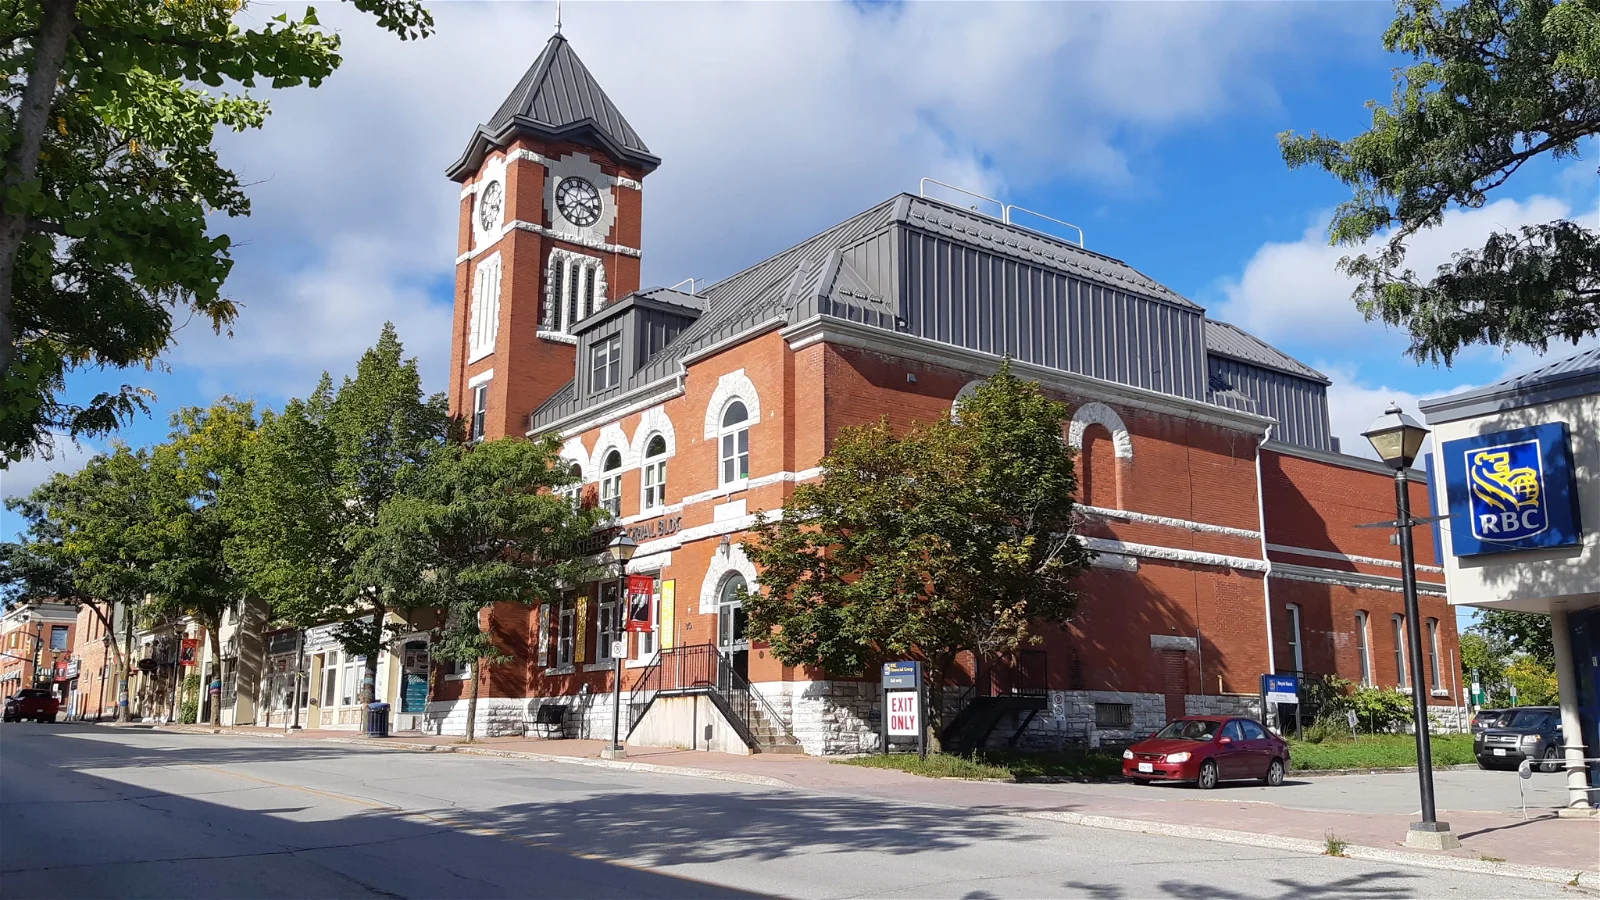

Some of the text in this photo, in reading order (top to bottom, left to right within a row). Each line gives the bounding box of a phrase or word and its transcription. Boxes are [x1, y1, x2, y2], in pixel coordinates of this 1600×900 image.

[659, 517, 682, 536] BLDG
[1479, 509, 1539, 534] RBC
[892, 697, 913, 712] EXIT
[891, 715, 915, 730] ONLY
